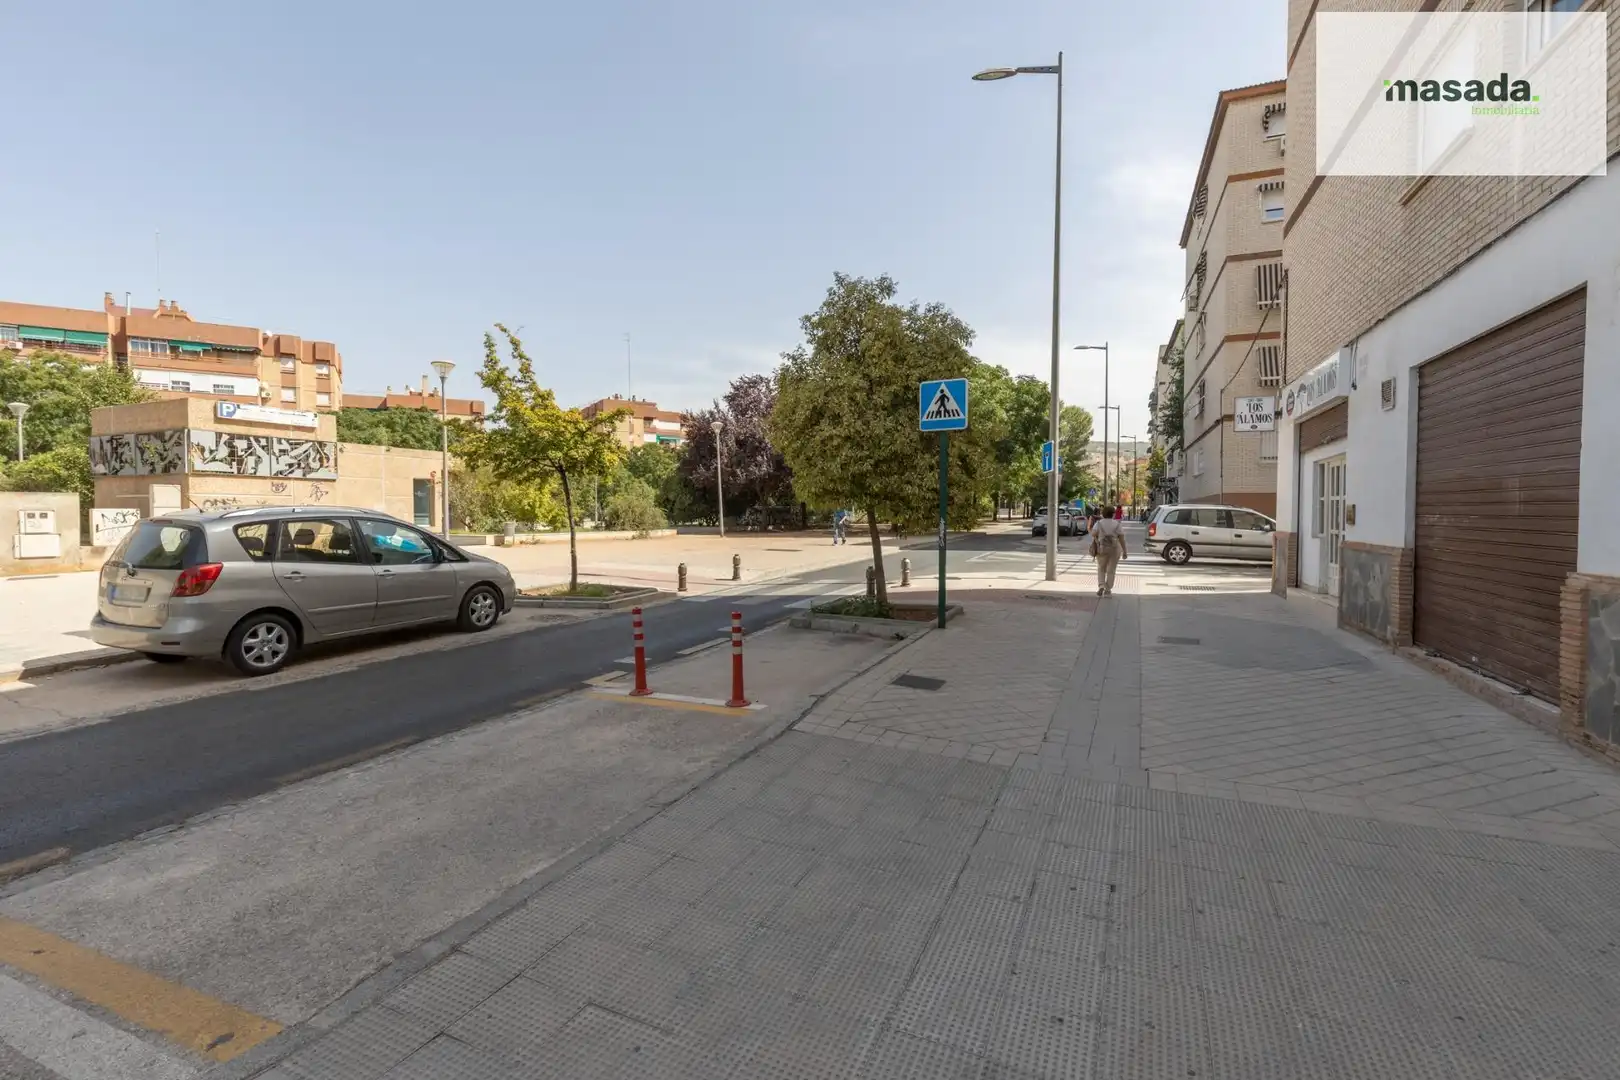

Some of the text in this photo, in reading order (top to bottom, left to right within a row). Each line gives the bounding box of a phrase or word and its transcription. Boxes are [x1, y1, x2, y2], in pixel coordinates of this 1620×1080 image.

[222, 403, 234, 416] P
[1246, 403, 1263, 413] LOS
[1236, 411, 1273, 424] ÁLAMOS
